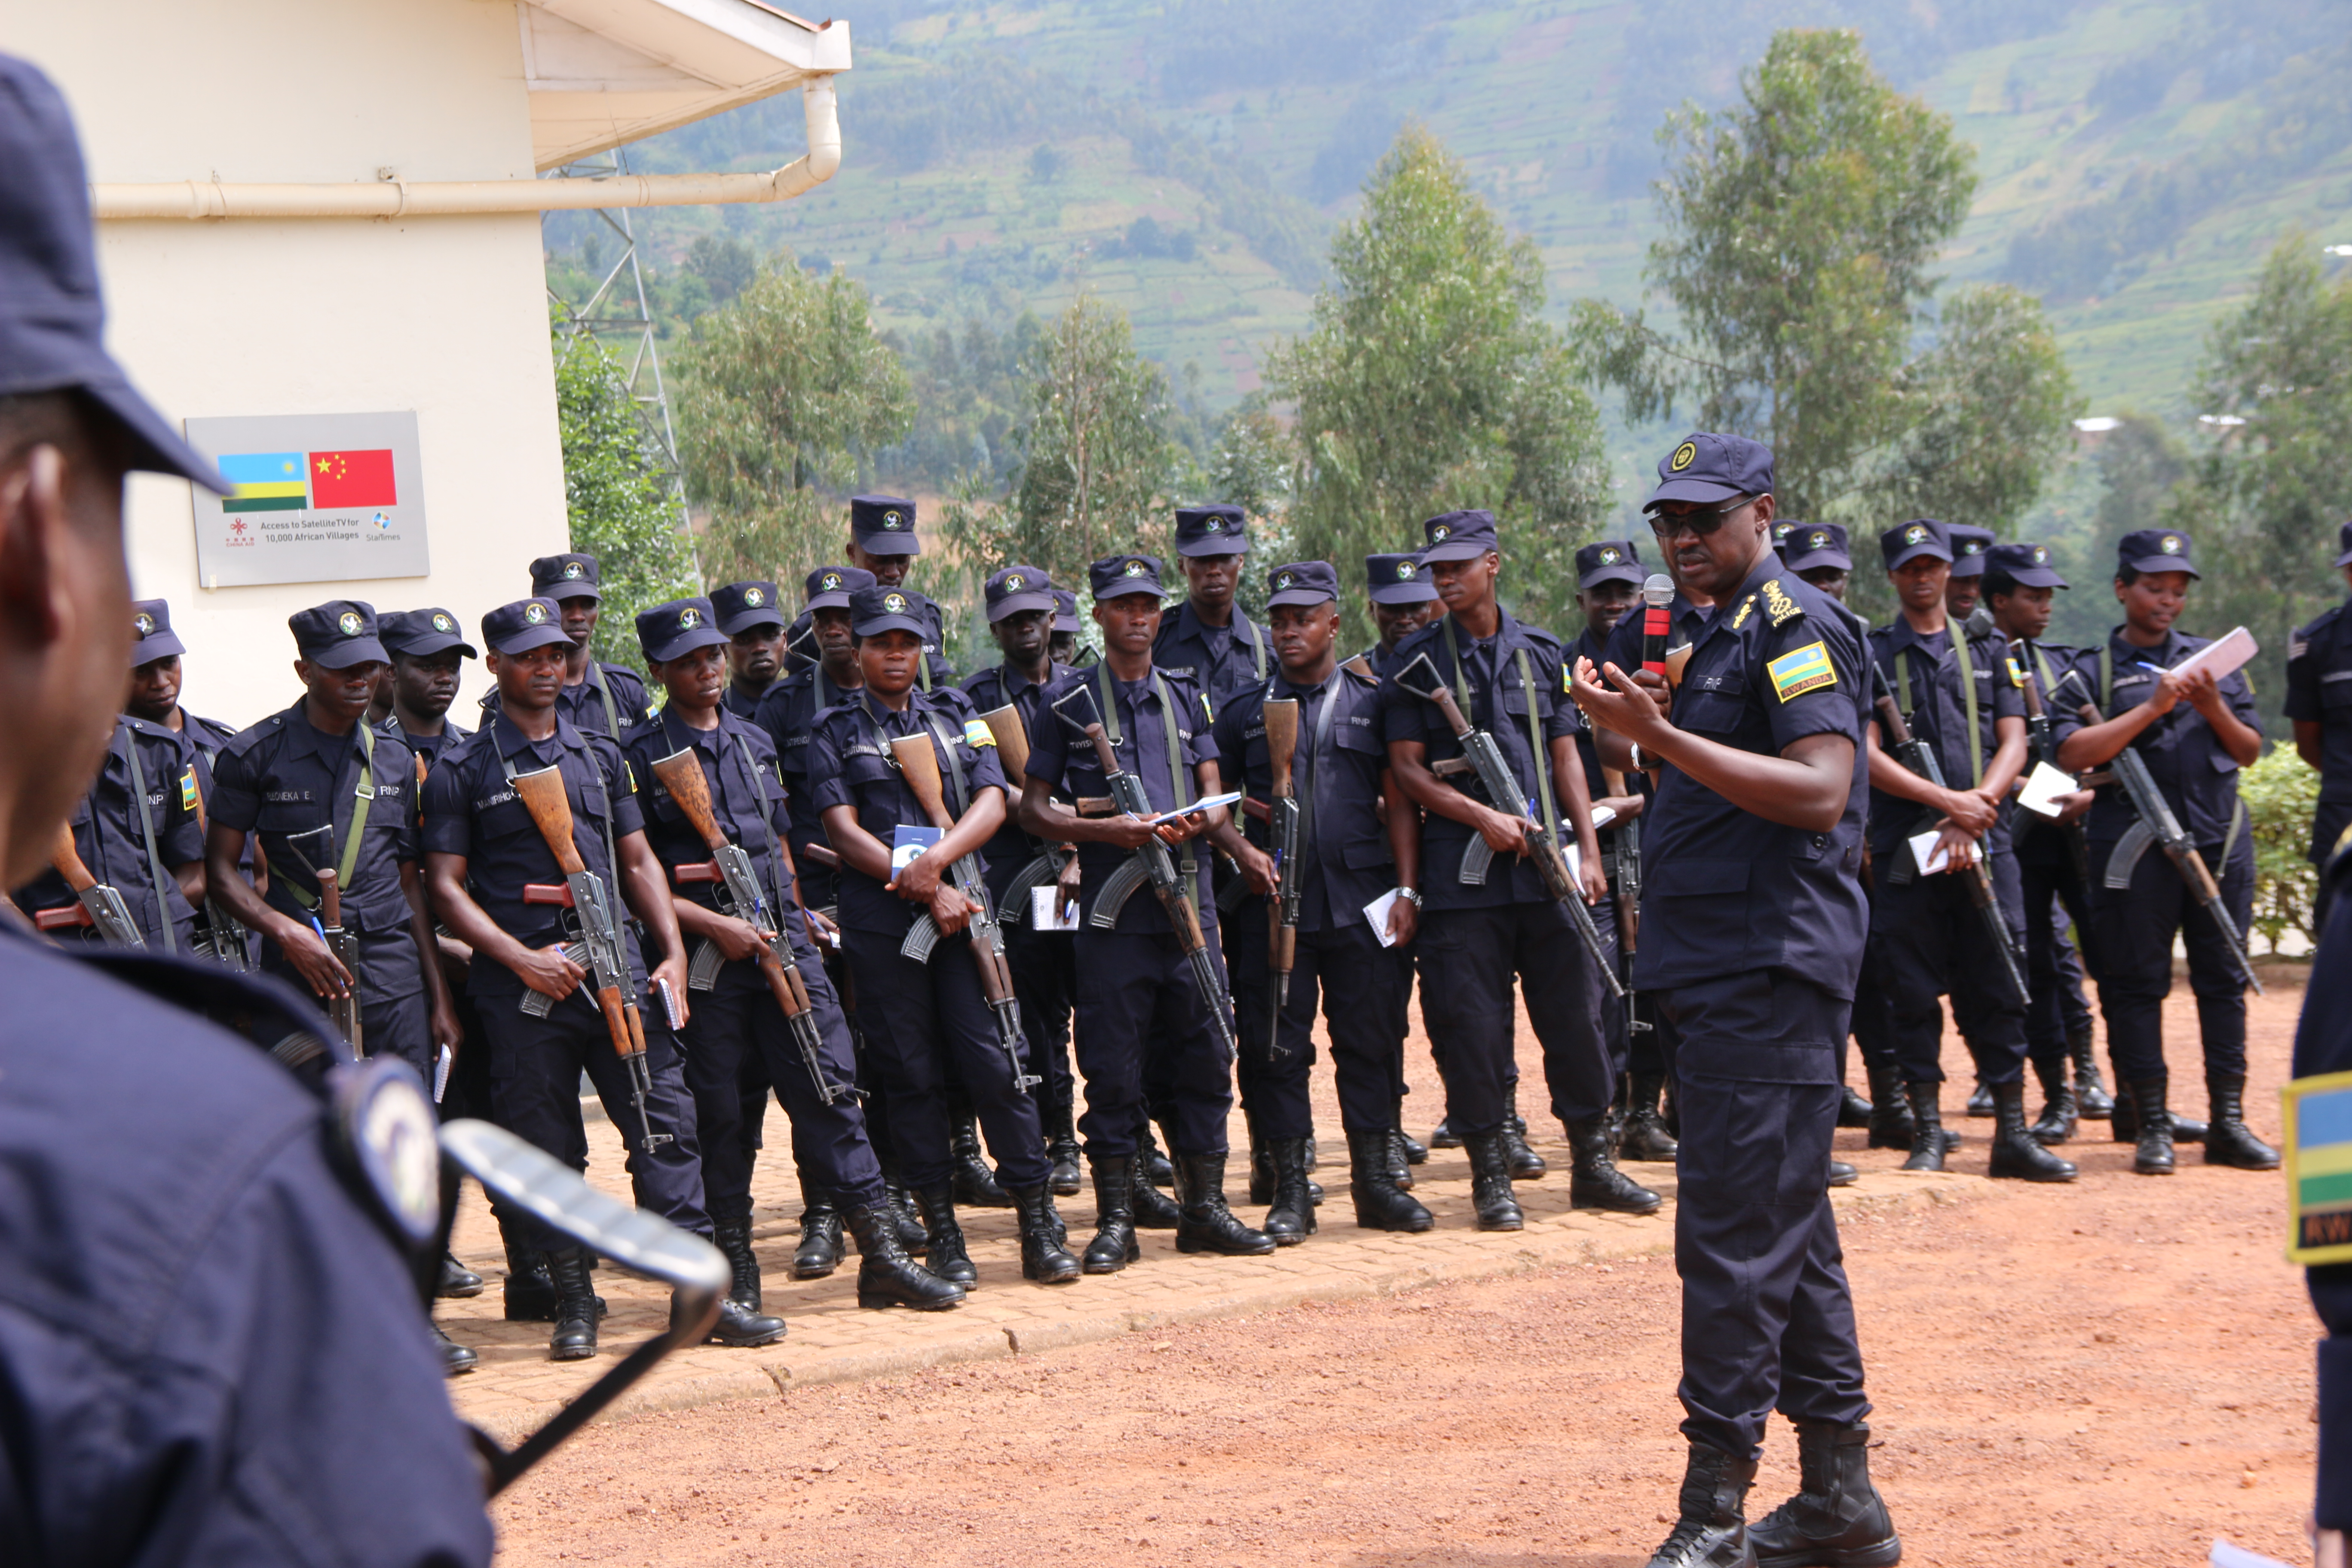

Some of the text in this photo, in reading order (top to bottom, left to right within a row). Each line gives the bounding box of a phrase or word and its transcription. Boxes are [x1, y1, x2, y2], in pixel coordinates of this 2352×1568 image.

[260, 521, 290, 530] Access
[302, 519, 336, 528] Satellite
[347, 518, 359, 526] for
[265, 534, 293, 543] 10,000
[295, 533, 325, 541] African
[326, 532, 359, 541] Villages
[366, 533, 401, 542] StarTimes
[1772, 606, 1802, 628] POLICE
[1784, 674, 1831, 697] RWANDA
[1351, 717, 1370, 727] RNP
[305, 791, 310, 799] E
[380, 785, 400, 796] RNP
[477, 792, 511, 809] MANIRIHO
